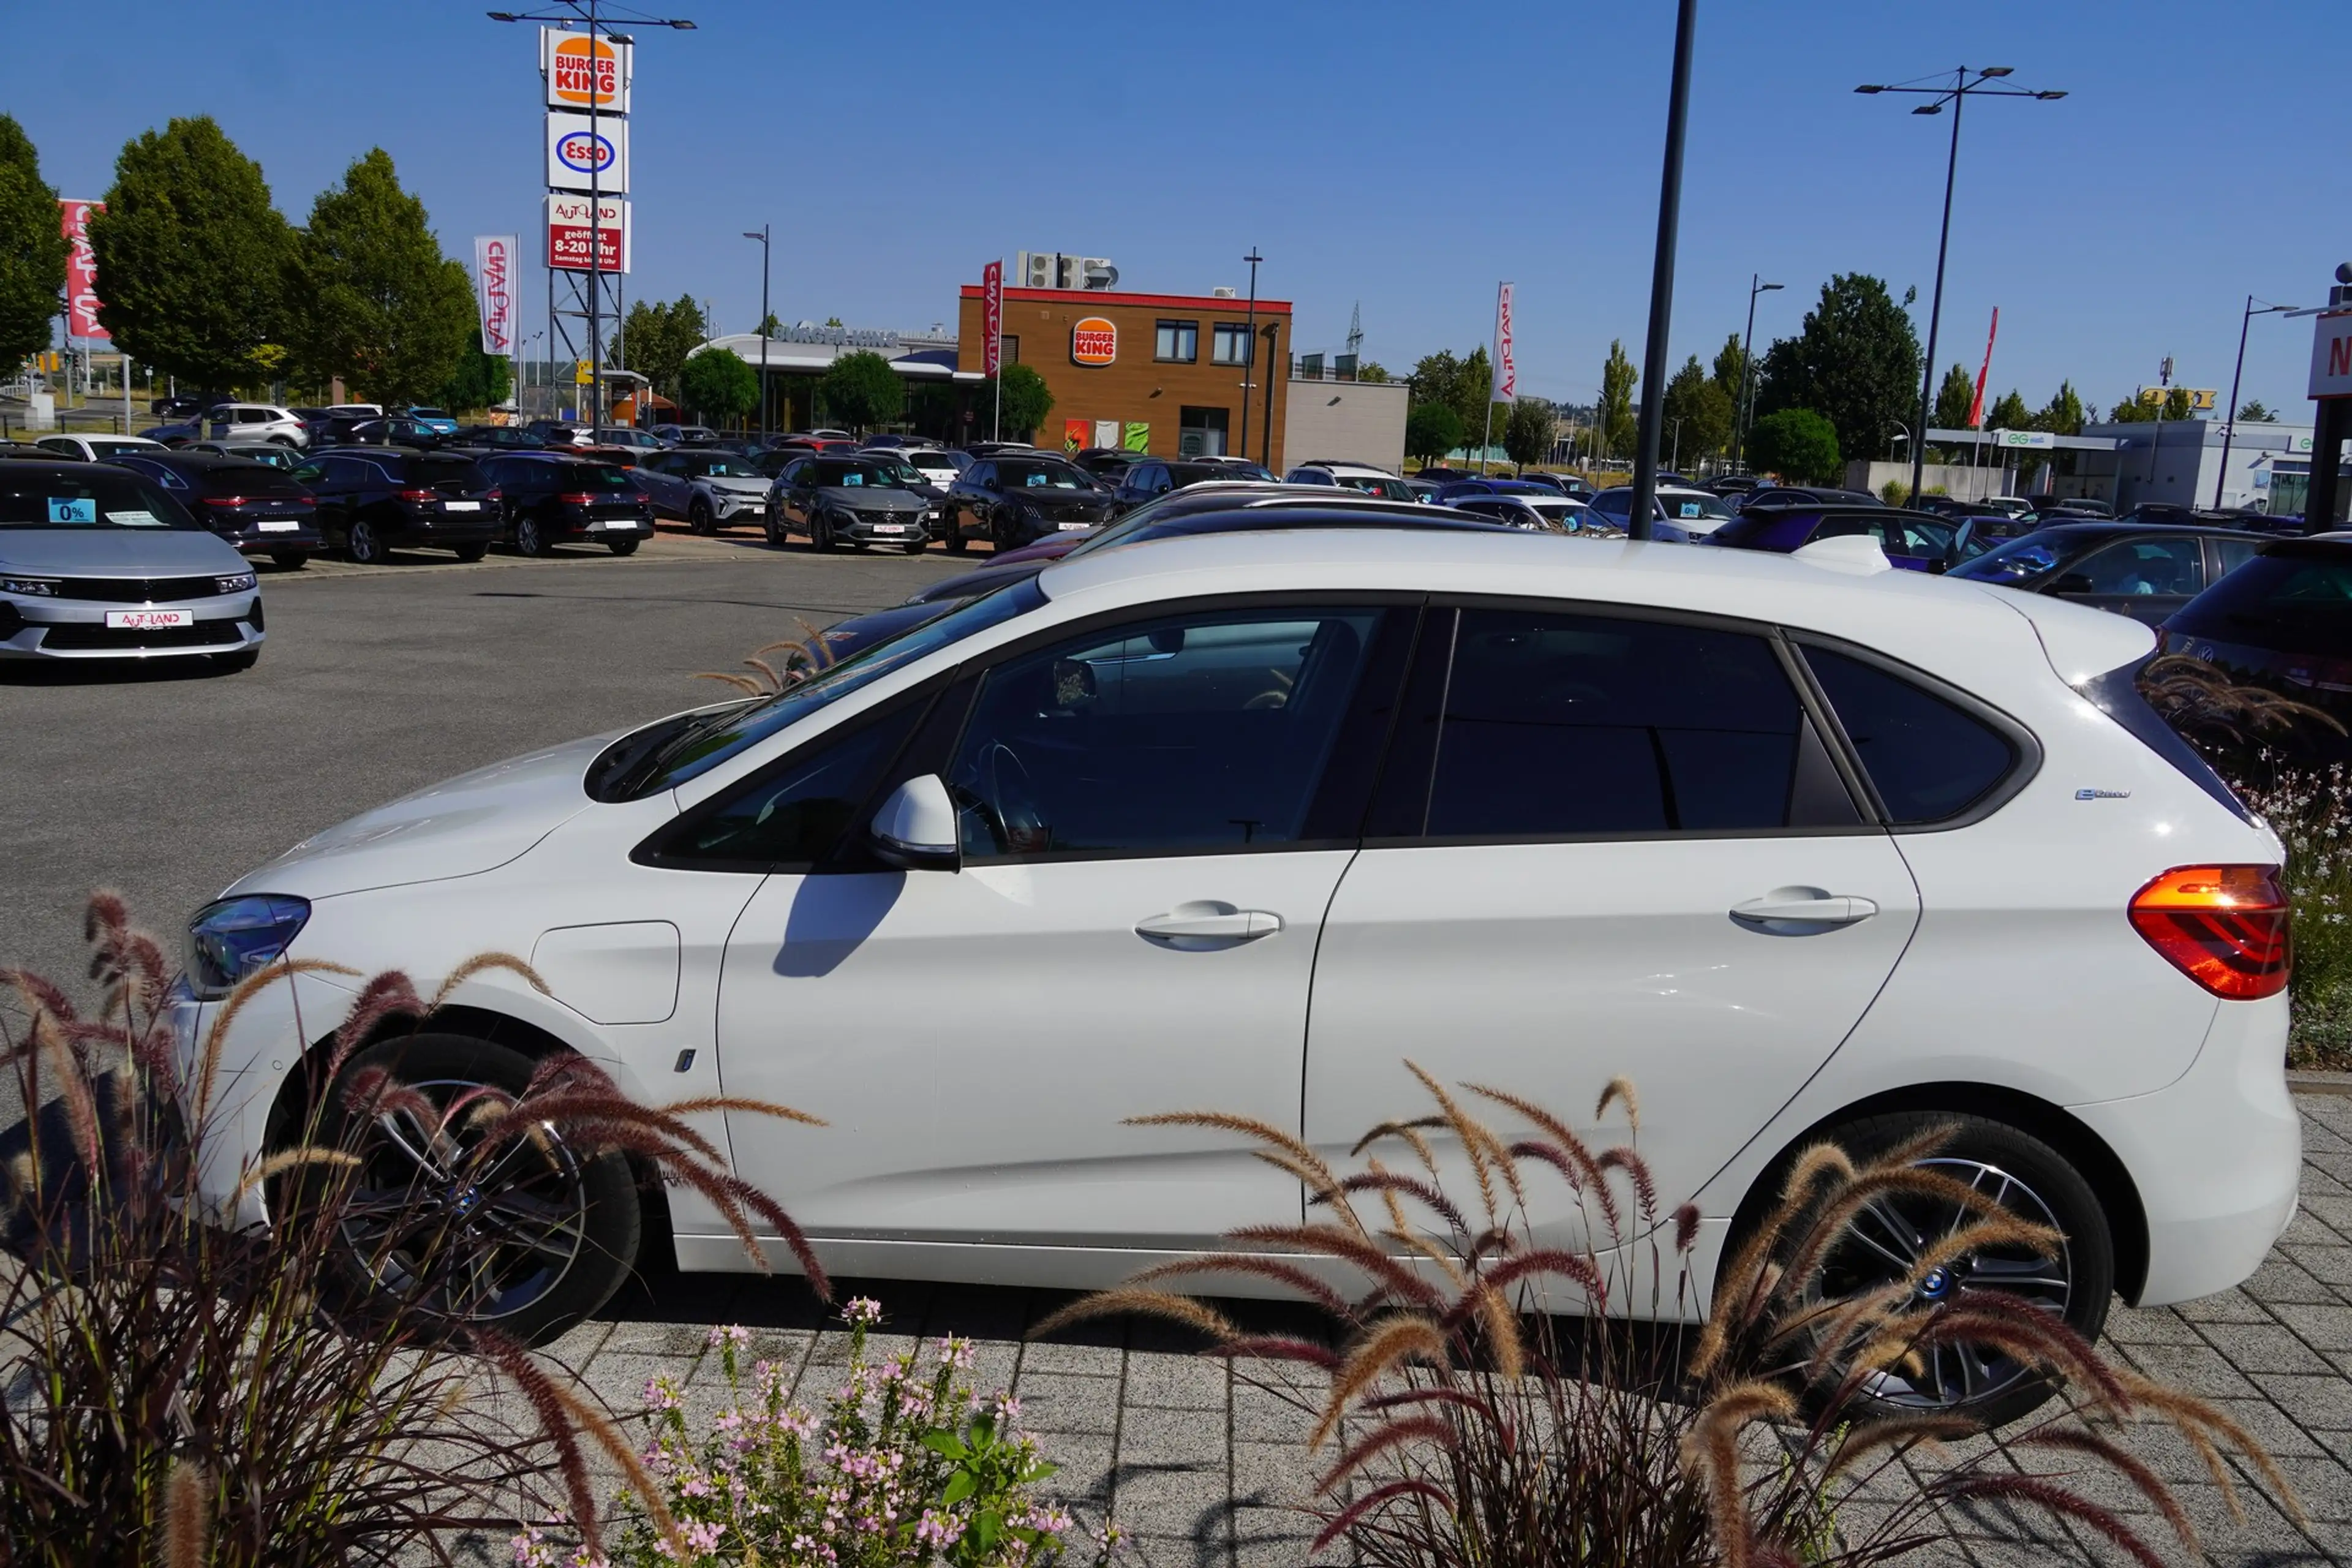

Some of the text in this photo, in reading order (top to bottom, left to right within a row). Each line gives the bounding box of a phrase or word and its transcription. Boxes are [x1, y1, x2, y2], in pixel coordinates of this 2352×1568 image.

[556, 70, 615, 92] KING
[556, 203, 616, 221] AUTOLND
[565, 230, 607, 241] geöffet
[555, 239, 586, 254] 8-20
[773, 326, 899, 349] BURGER KING
[1076, 333, 1114, 342] BURGER
[1501, 287, 1516, 398] AUTOLAND
[1076, 342, 1114, 355] KING
[59, 505, 84, 521] 0%
[123, 613, 179, 627] AUTOLAND
